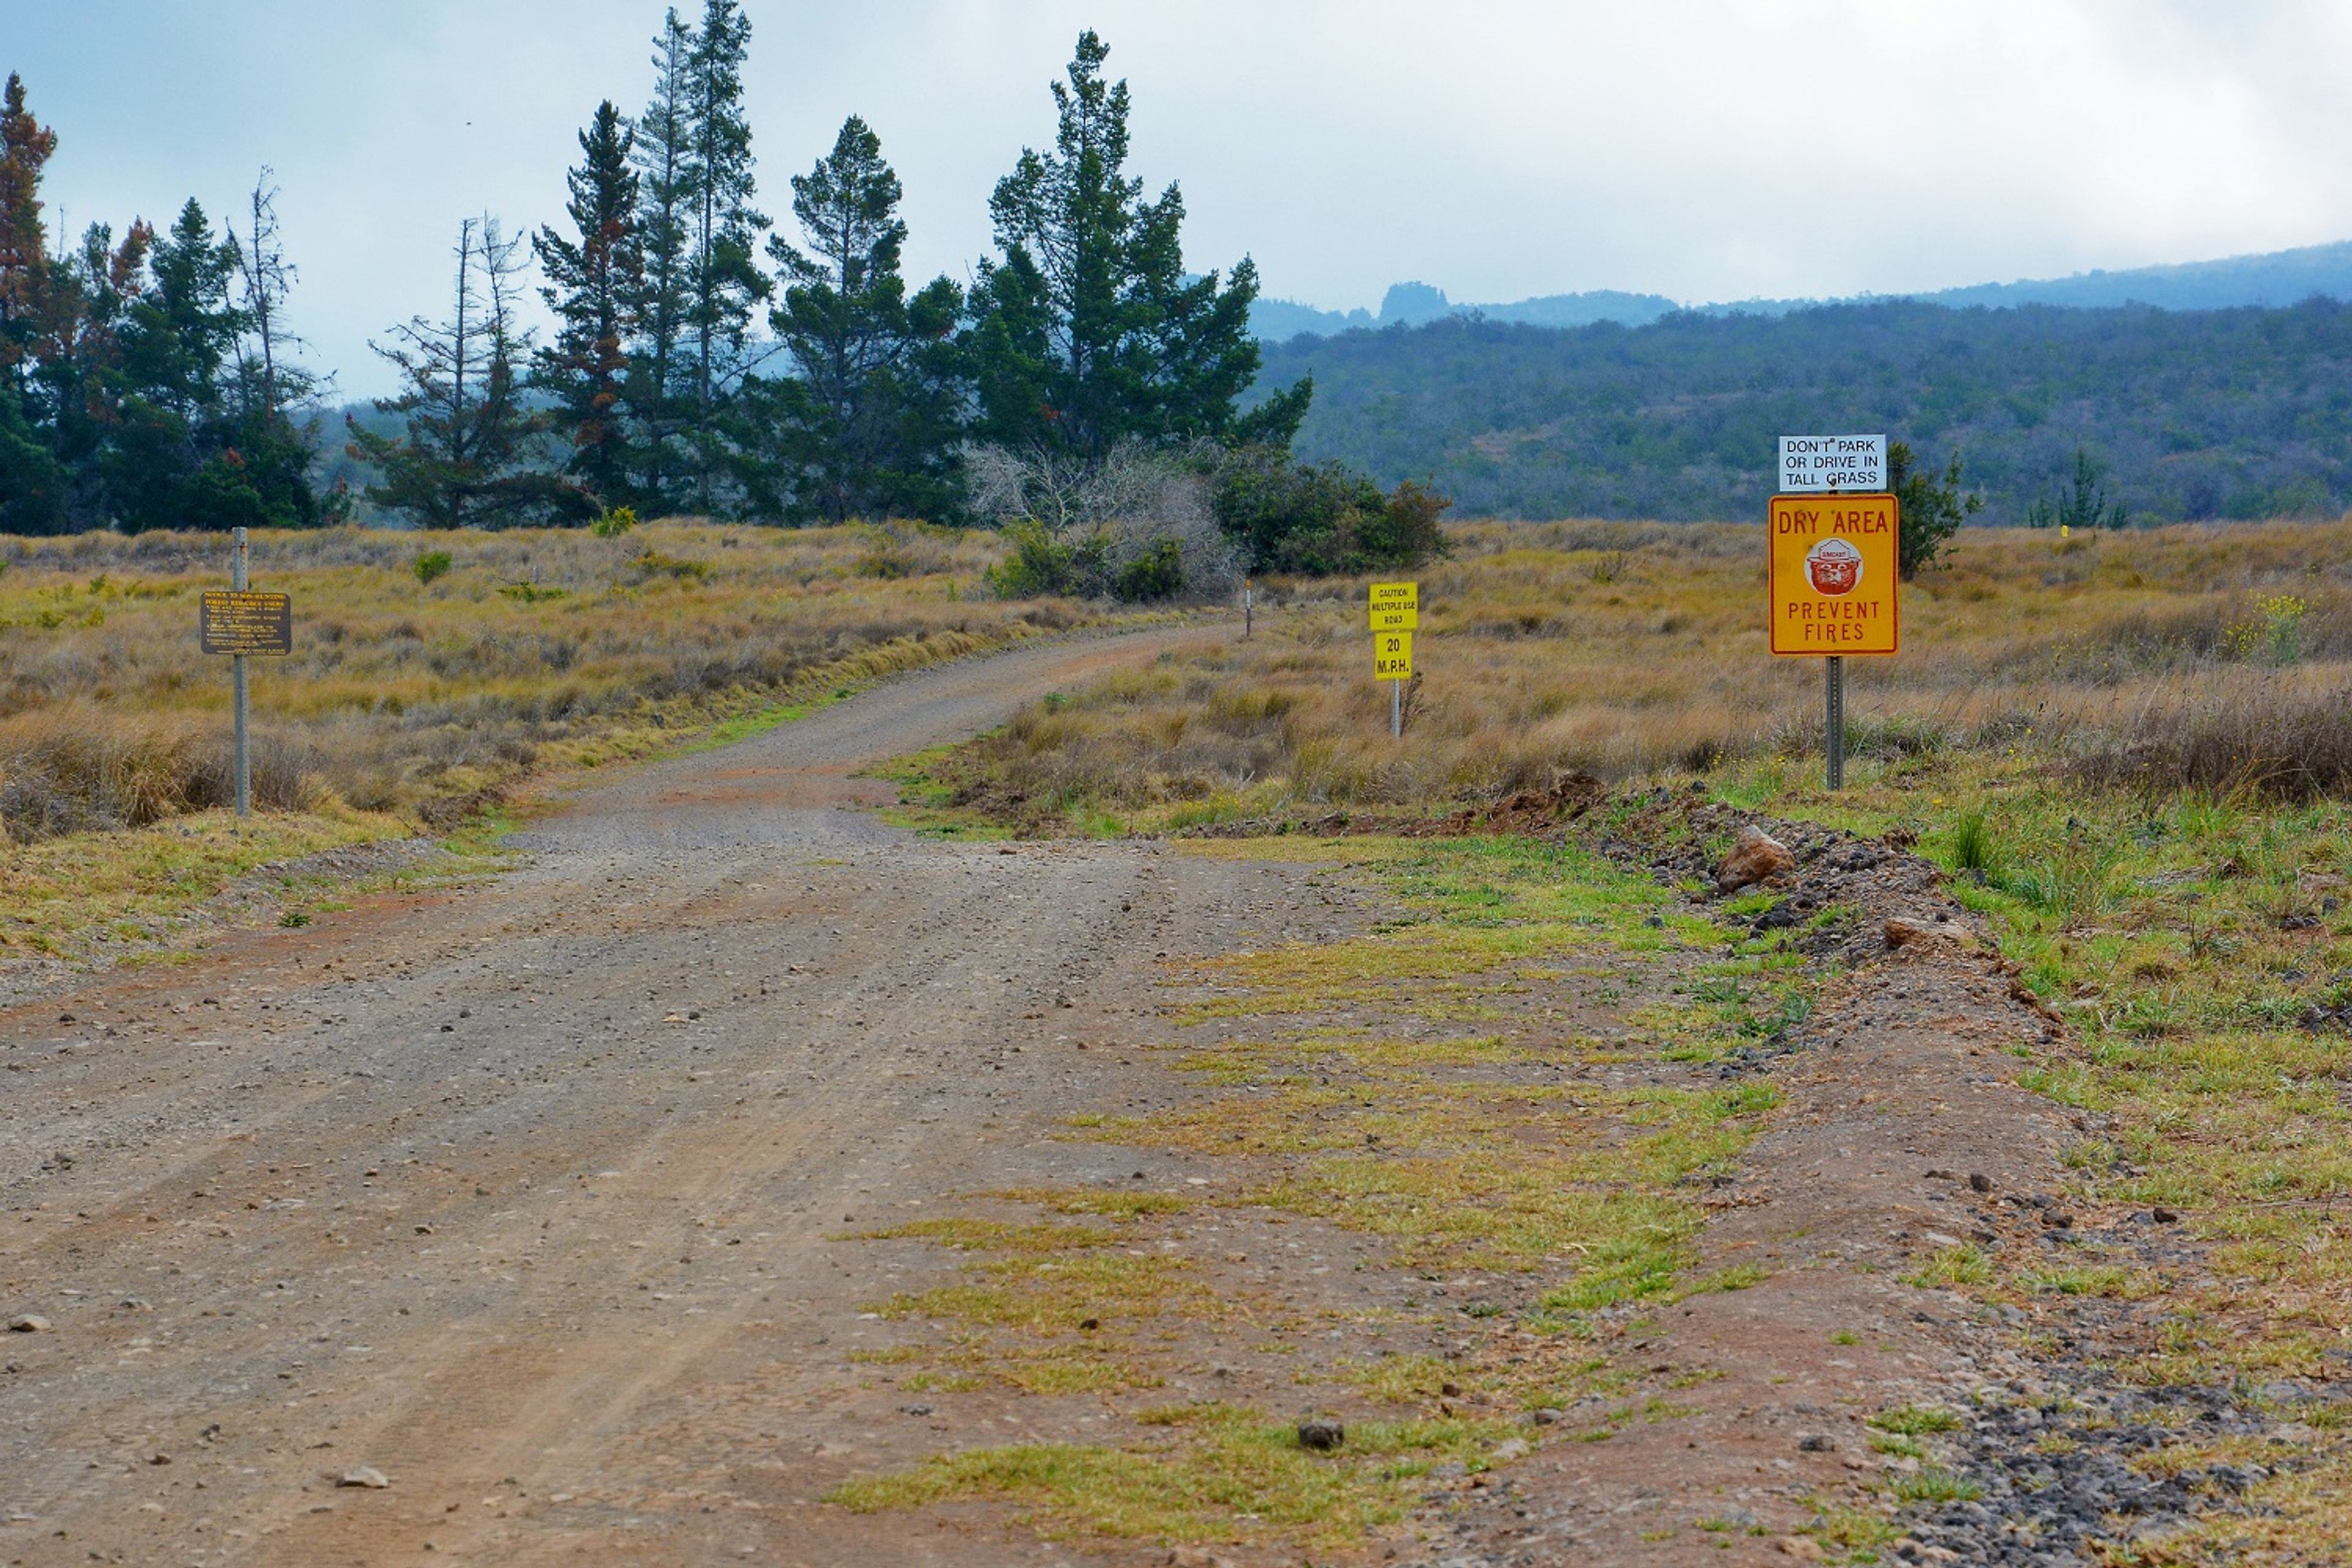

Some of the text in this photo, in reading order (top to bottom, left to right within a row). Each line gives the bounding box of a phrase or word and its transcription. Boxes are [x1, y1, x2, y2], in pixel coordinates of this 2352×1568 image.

[1787, 440, 1876, 453] DON'T PARK
[1785, 455, 1878, 469] OR DRIVE IN
[1786, 471, 1877, 485] TALL GRASS
[1779, 510, 1888, 534] DRY AREA
[1379, 588, 1408, 598] CAUTION
[1372, 601, 1415, 611] MULTIPLE USE
[1789, 602, 1879, 619] PREVENT
[1384, 615, 1403, 624] ROAD
[1804, 624, 1863, 641] FIRES
[1387, 638, 1400, 652] 20
[1377, 658, 1409, 673] M.P.H.
